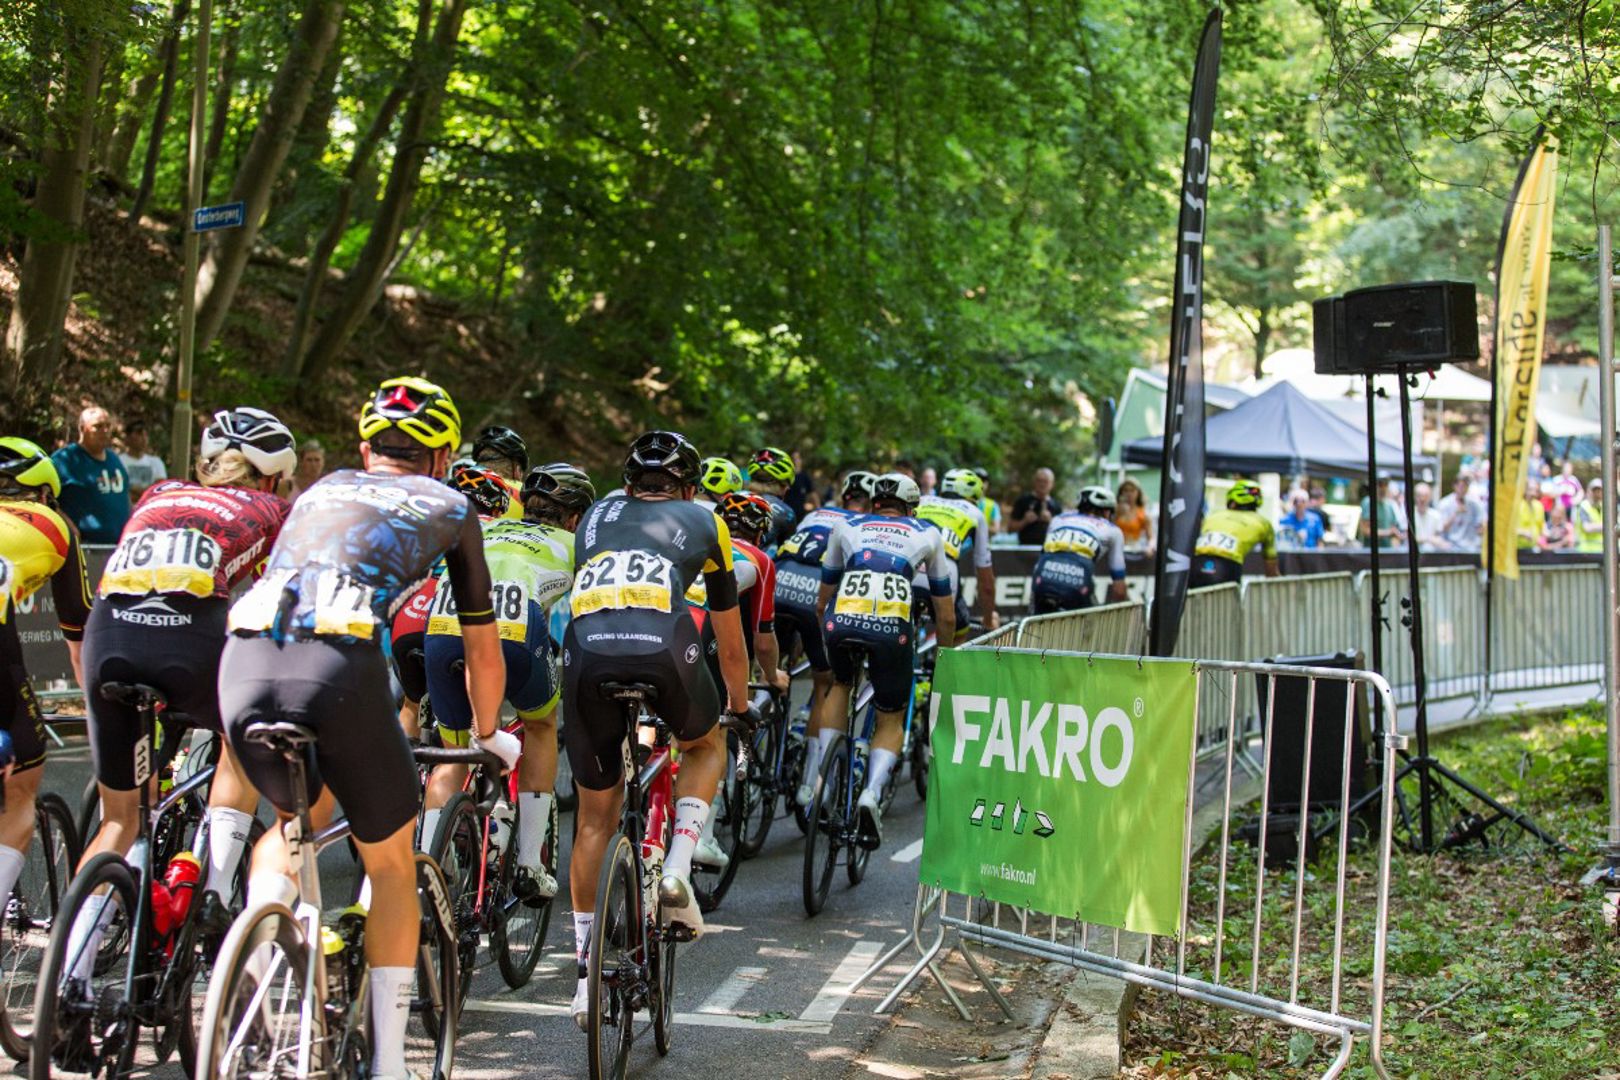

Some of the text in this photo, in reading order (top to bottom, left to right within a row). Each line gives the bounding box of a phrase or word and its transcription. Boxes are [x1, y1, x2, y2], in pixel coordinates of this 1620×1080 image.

[861, 526, 910, 538] SOUDAL
[165, 532, 214, 570] 116
[225, 537, 266, 582] GIANT
[580, 556, 616, 591] 52
[626, 553, 665, 586] 52
[1044, 560, 1085, 578] RENSON
[844, 573, 909, 601] 55 55
[493, 584, 522, 621] 18
[111, 608, 193, 627] VREDESTEIN
[836, 615, 900, 635] OUTDOOR
[587, 632, 663, 644] CYCLING VLAANDEREN
[951, 694, 1134, 788] FAKRO
[980, 862, 1037, 886] www.fakro.nl
